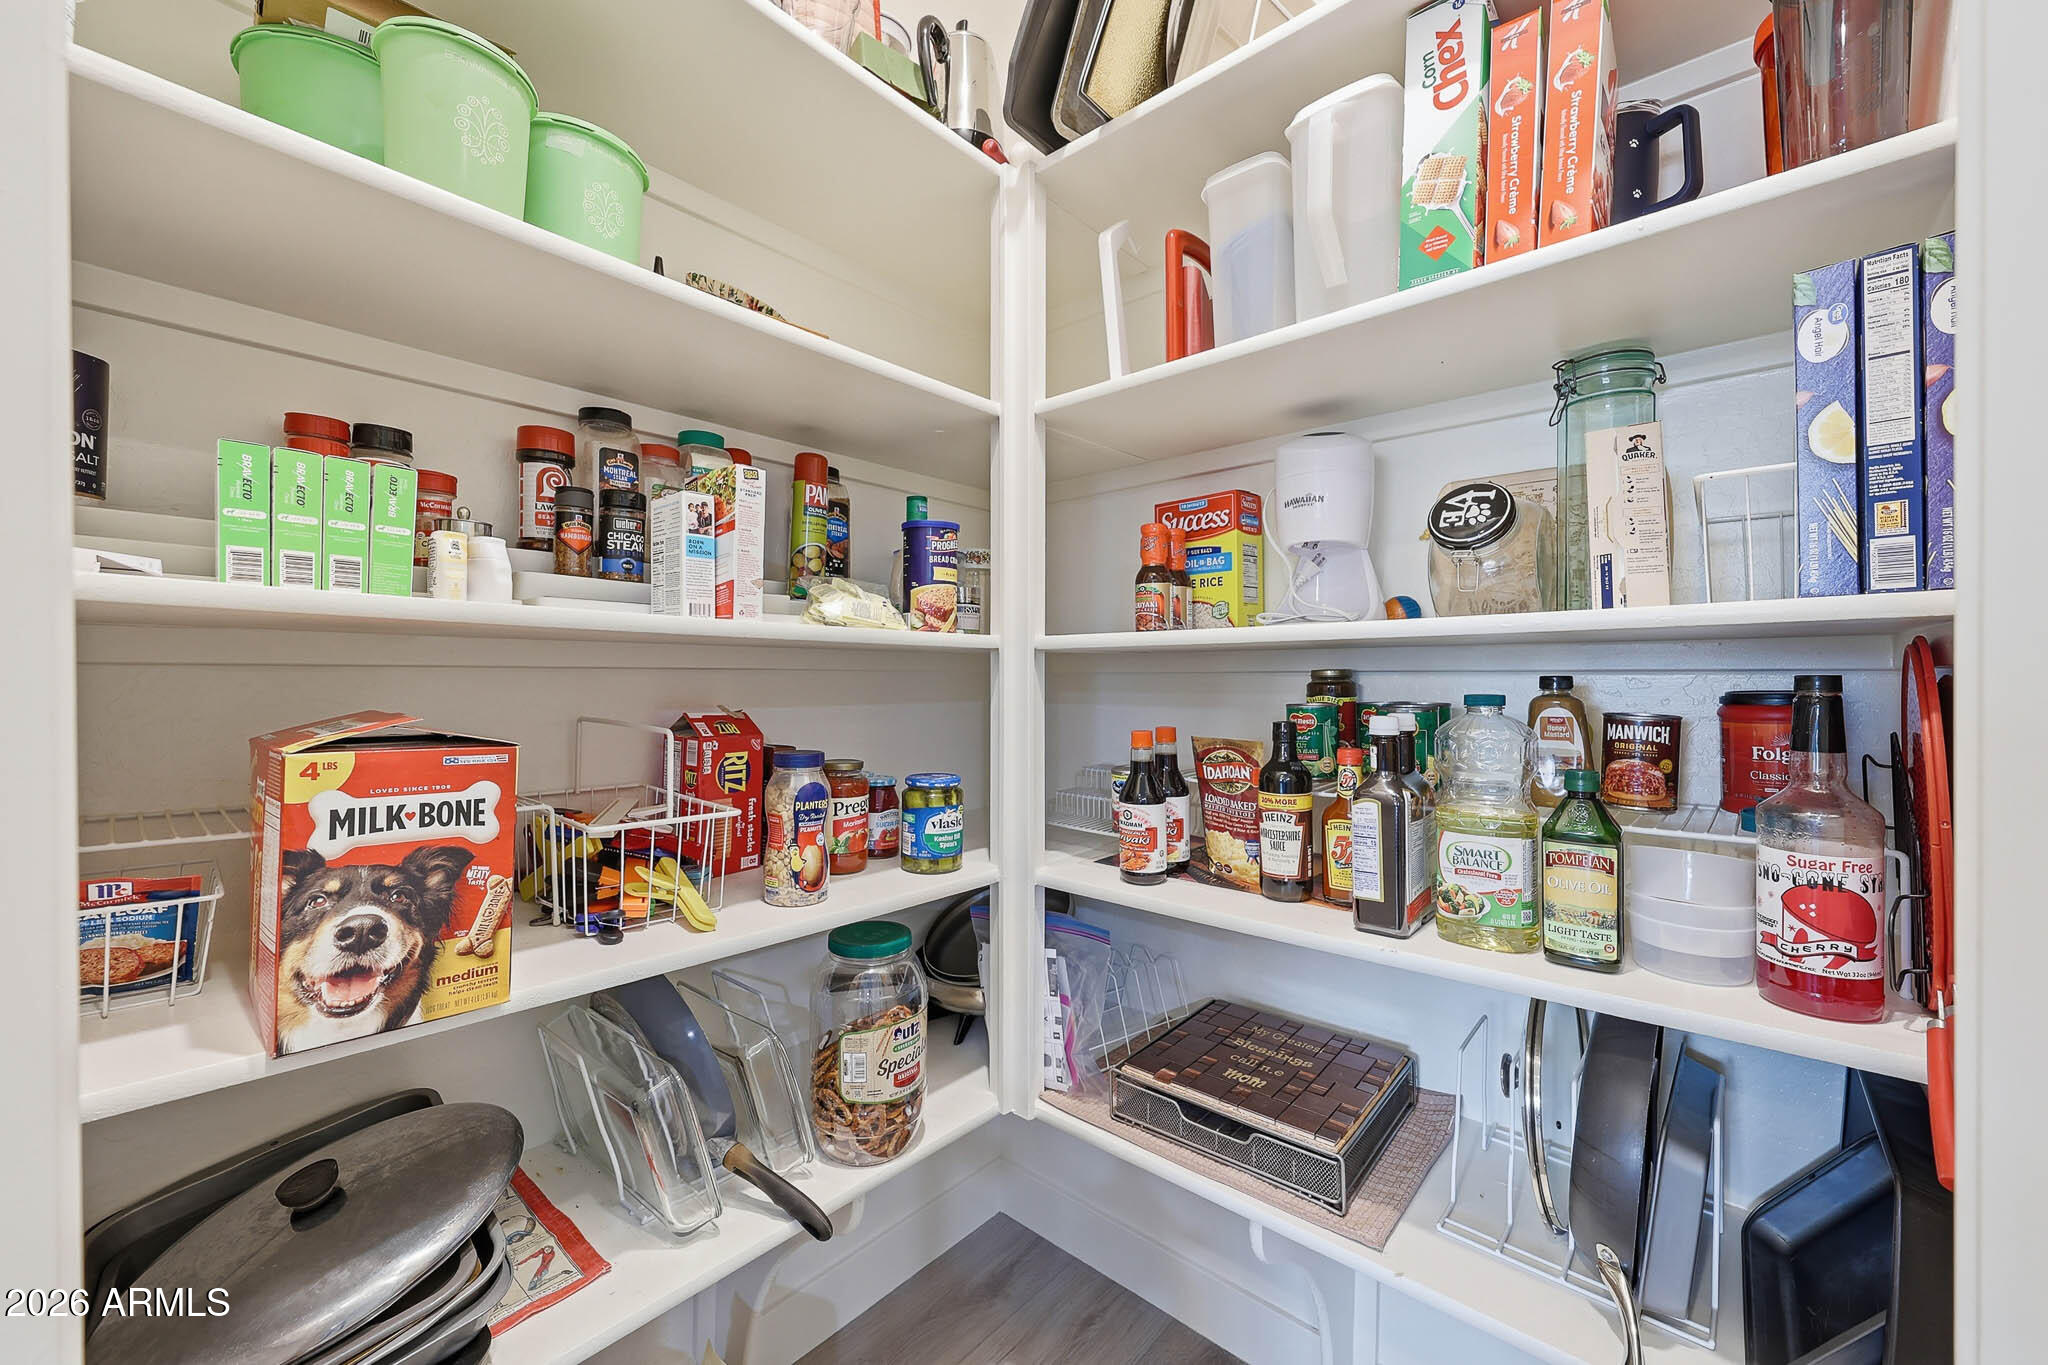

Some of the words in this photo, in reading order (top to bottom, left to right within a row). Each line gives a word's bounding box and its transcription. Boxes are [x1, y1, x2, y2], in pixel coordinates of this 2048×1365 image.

[1422, 50, 1435, 89] corn
[1433, 19, 1469, 110] Chex
[1568, 89, 1582, 153] Strawberry
[1511, 115, 1521, 173] Strawberry
[1566, 154, 1579, 195] Crème
[1508, 174, 1520, 215] Crème
[1867, 256, 1891, 266] Nutrition
[1892, 252, 1909, 260] Facts
[1867, 283, 1891, 292] Calories
[1895, 276, 1909, 285] 180
[1812, 318, 1824, 339] Angel
[1814, 341, 1824, 357] Hair
[1622, 452, 1656, 462] QUAKER
[240, 454, 255, 502] BRAVECTO
[603, 466, 638, 478] MONTREAL
[295, 461, 308, 508] BRAVECTO
[343, 470, 357, 514] BRAVECTO
[1284, 496, 1324, 509] HAWAIIAN
[1162, 509, 1230, 532] Success
[607, 532, 645, 543] CHICAGO
[607, 540, 644, 552] STEAK
[929, 555, 949, 563] BREAD
[1200, 576, 1223, 588] RICE
[1607, 723, 1671, 745] MANWICH
[1614, 742, 1658, 752] ORIGINAL
[1752, 746, 1790, 765] Folg
[299, 762, 320, 780] 4
[322, 762, 338, 770] LBS
[723, 751, 748, 794] RITZ
[1203, 765, 1250, 780] IDAHOAN
[1750, 770, 1791, 781] Classic
[748, 798, 757, 821] fresh
[796, 800, 828, 811] PLANTERS
[833, 800, 868, 816] Preg
[1274, 798, 1297, 806] MORE
[329, 804, 408, 840] MILK
[419, 798, 486, 828] BONE
[1264, 813, 1293, 824] HEINZ
[747, 824, 757, 853] stacks
[1270, 841, 1286, 851] SAUCE
[1454, 845, 1501, 860] SMART
[1452, 856, 1504, 871] BALANCE
[1549, 852, 1610, 871] POMPEIAN
[1787, 855, 1836, 872] Sugar
[1842, 861, 1873, 874] Free
[466, 869, 490, 879] MEATY
[468, 878, 486, 886] Taste
[1547, 875, 1585, 891] OLIVE
[1589, 881, 1613, 896] OIL
[1548, 924, 1578, 937] LIGHT
[1580, 929, 1612, 942] TASTE
[1780, 943, 1853, 953] CHERRY
[436, 965, 499, 987] medium
